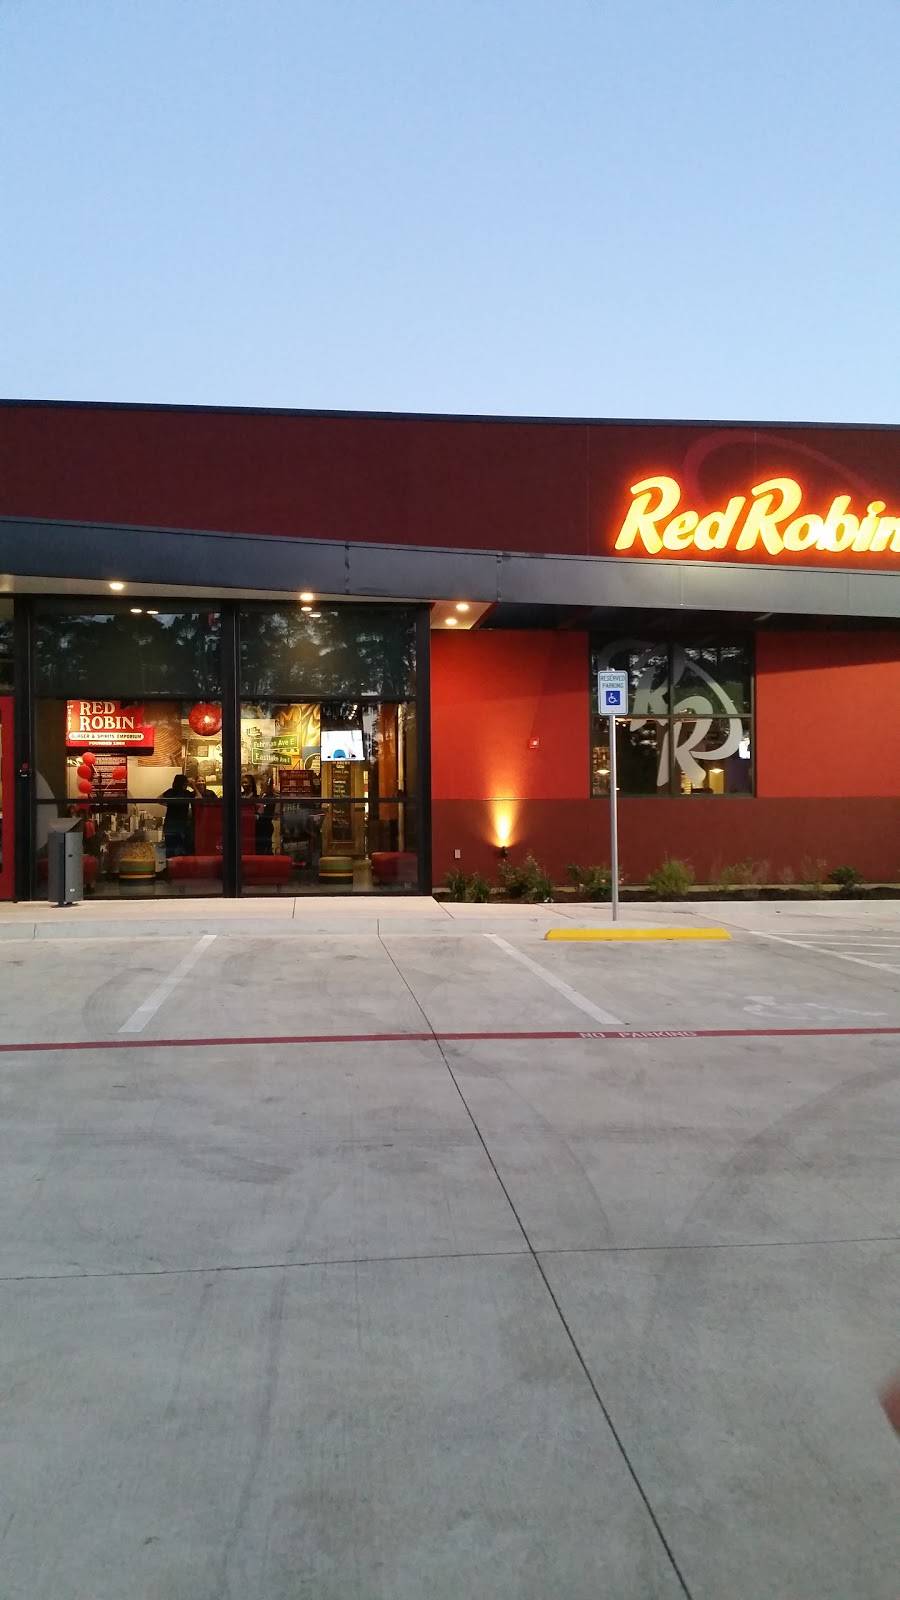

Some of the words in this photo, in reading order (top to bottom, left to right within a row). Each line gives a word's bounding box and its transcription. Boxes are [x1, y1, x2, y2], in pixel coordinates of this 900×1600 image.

[614, 476, 746, 555] Red
[79, 701, 116, 715] RED
[79, 715, 135, 732] ROBIN
[617, 1031, 698, 1039] PARKING
